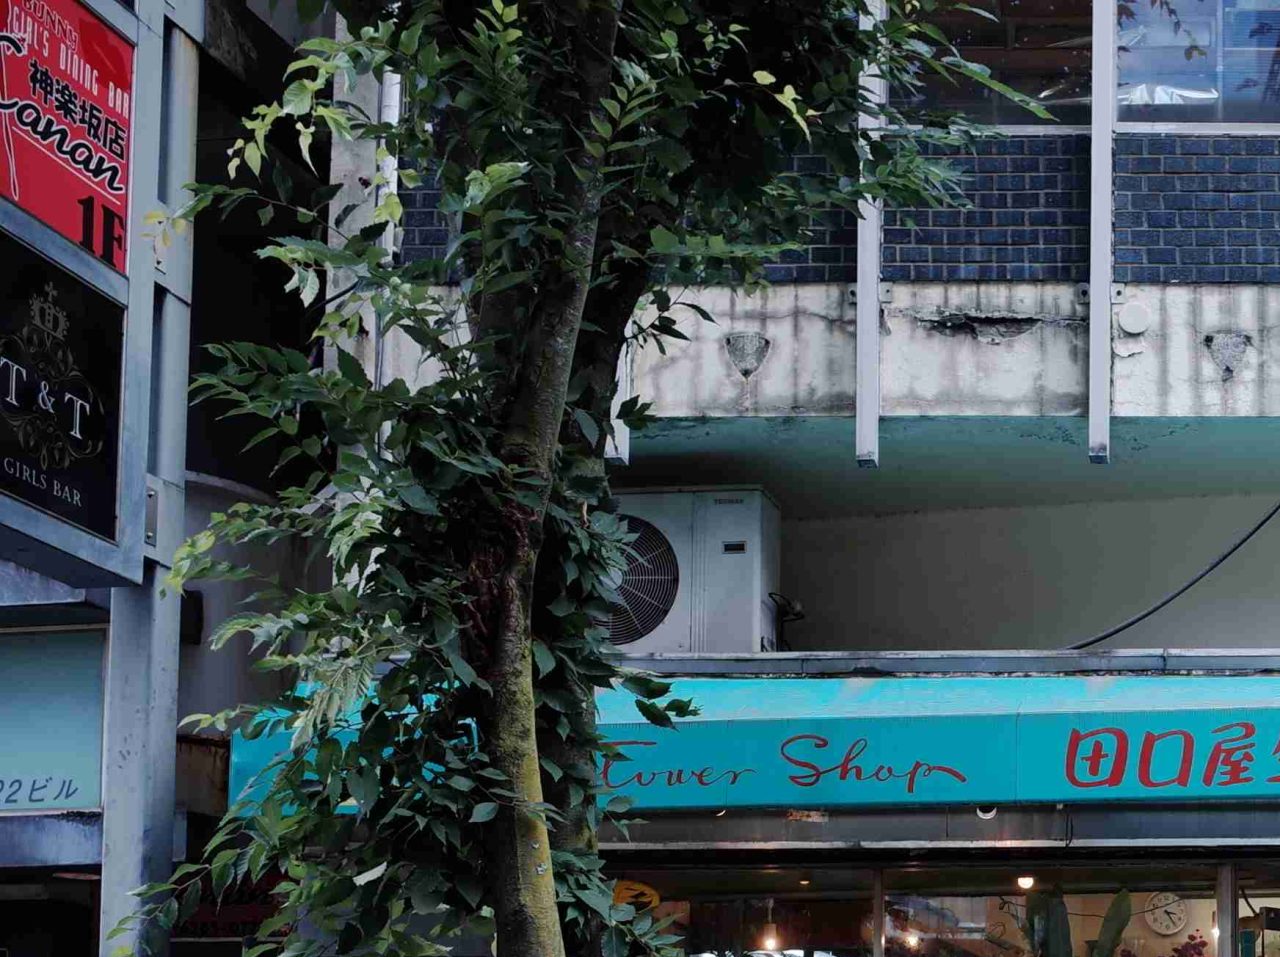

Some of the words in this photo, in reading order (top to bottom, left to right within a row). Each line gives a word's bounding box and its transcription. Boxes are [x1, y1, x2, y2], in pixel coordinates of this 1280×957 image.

[29, 58, 126, 160] 神楽坂店
[59, 43, 98, 98] DINING
[108, 82, 129, 118] BAR
[77, 196, 124, 268] 1F
[0, 357, 26, 407] T
[38, 380, 55, 414] &
[64, 391, 90, 440] T
[4, 457, 47, 490] GIRLS
[53, 479, 82, 507] BAR
[781, 734, 966, 793] Shop
